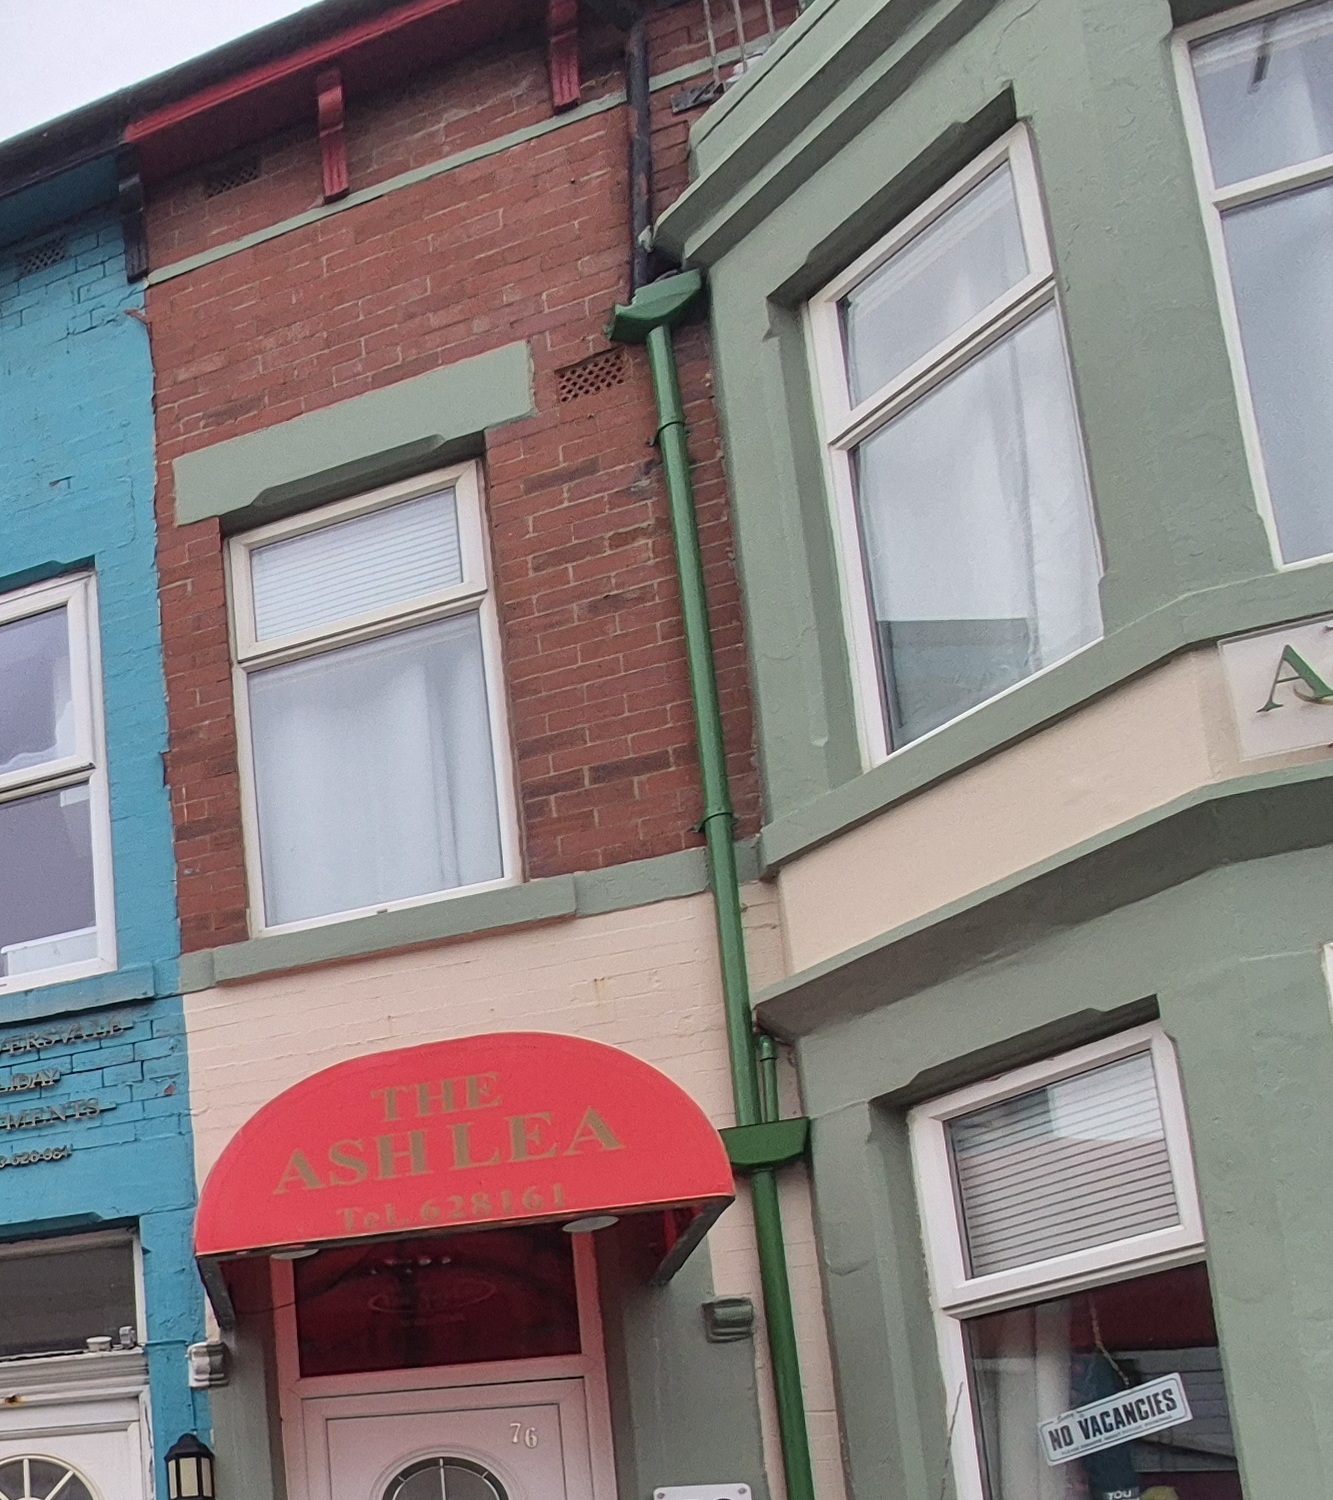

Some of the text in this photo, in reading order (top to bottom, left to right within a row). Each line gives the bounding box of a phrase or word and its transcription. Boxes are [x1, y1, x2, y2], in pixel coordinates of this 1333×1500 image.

[370, 1071, 503, 1122] THE
[272, 1105, 626, 1195] ASH LEA
[336, 1183, 566, 1231] Tel. 628161
[509, 1422, 538, 1449] 76
[1048, 1424, 1074, 1451] NO
[1077, 1387, 1178, 1440] VACANCIES
